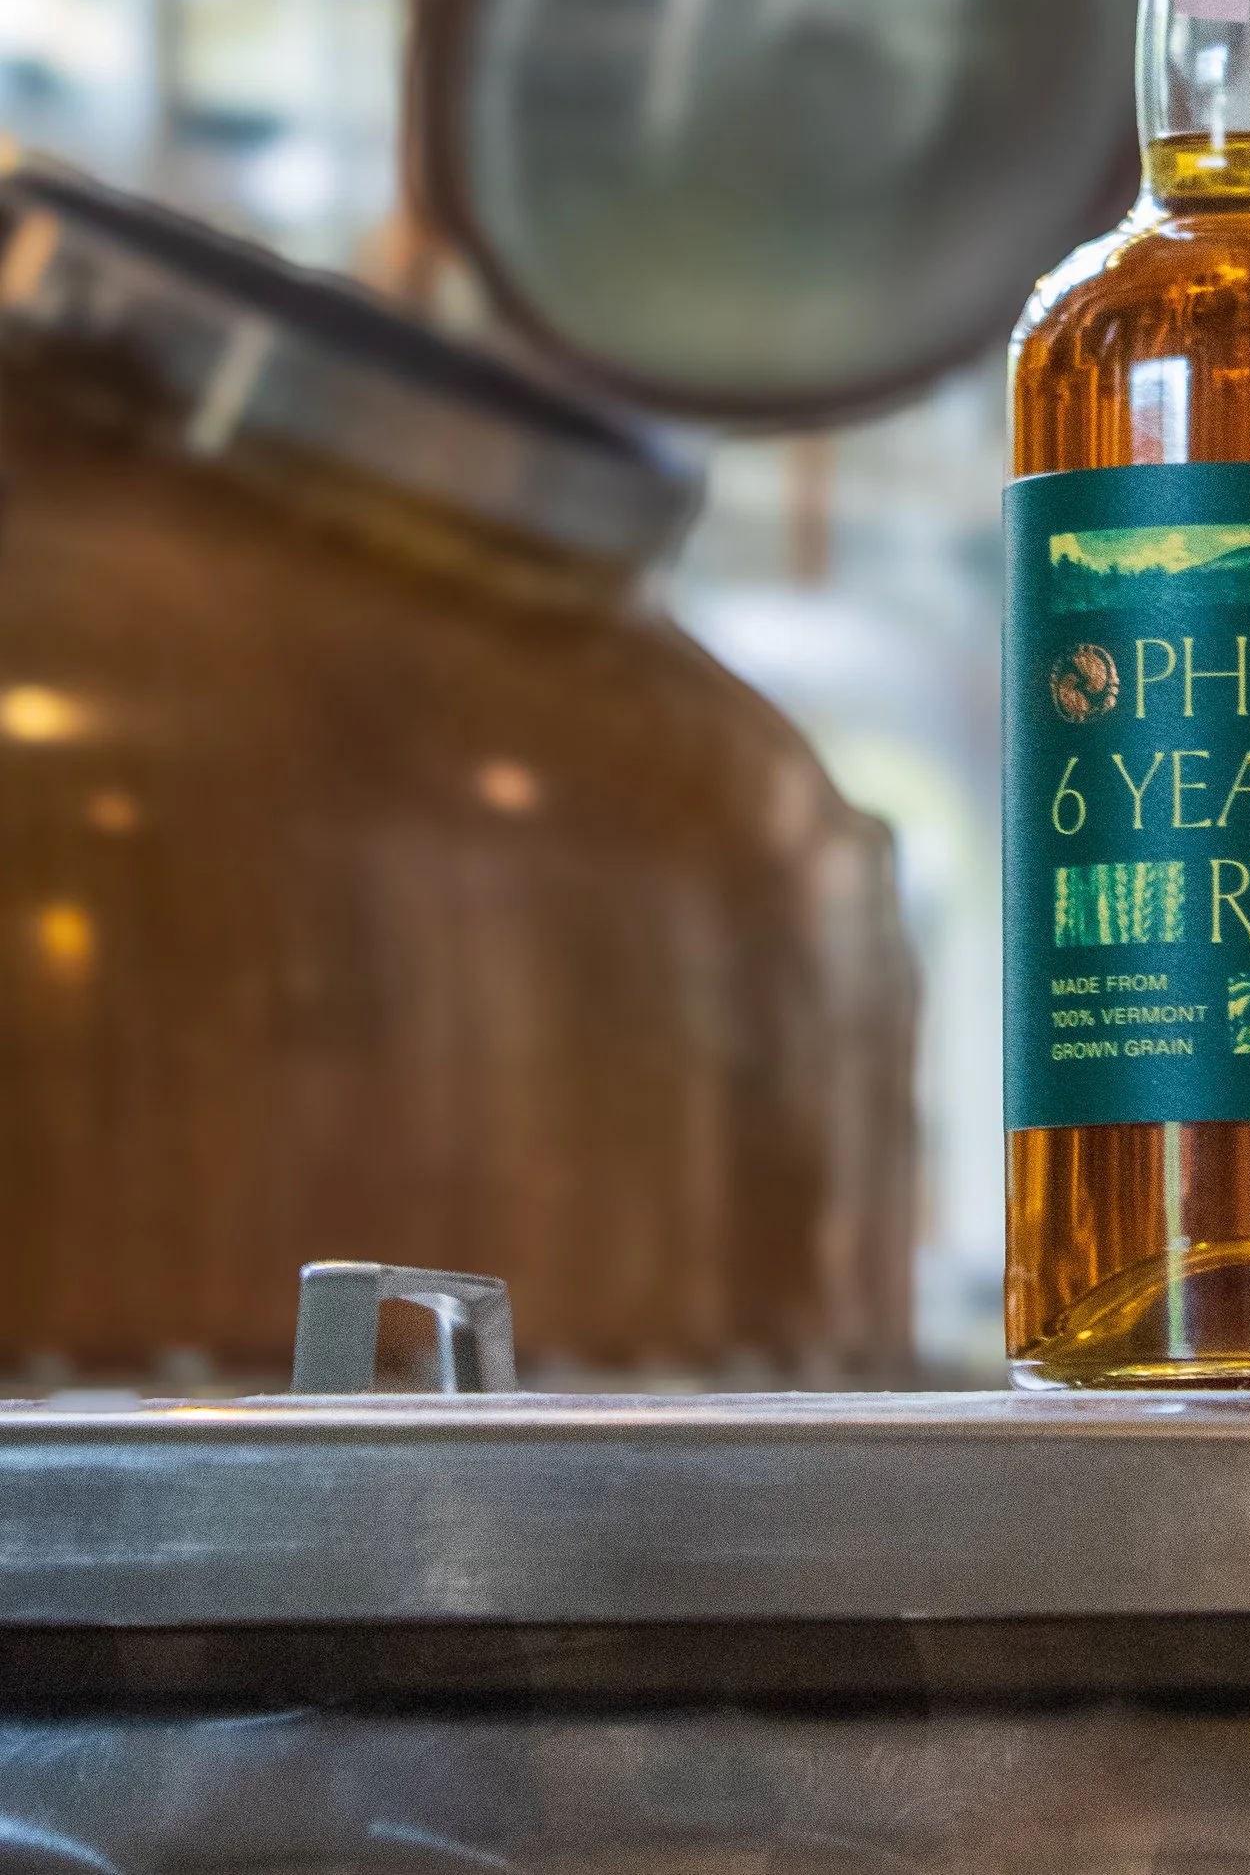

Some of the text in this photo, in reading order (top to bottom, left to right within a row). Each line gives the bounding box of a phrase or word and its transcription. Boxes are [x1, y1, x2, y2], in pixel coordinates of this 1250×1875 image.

[1052, 756, 1087, 835] 6
[1051, 974, 1168, 995] MADE FROM
[1051, 1005, 1209, 1028] 100% VERMONT
[1052, 1039, 1194, 1061] GROWN GRAIN
